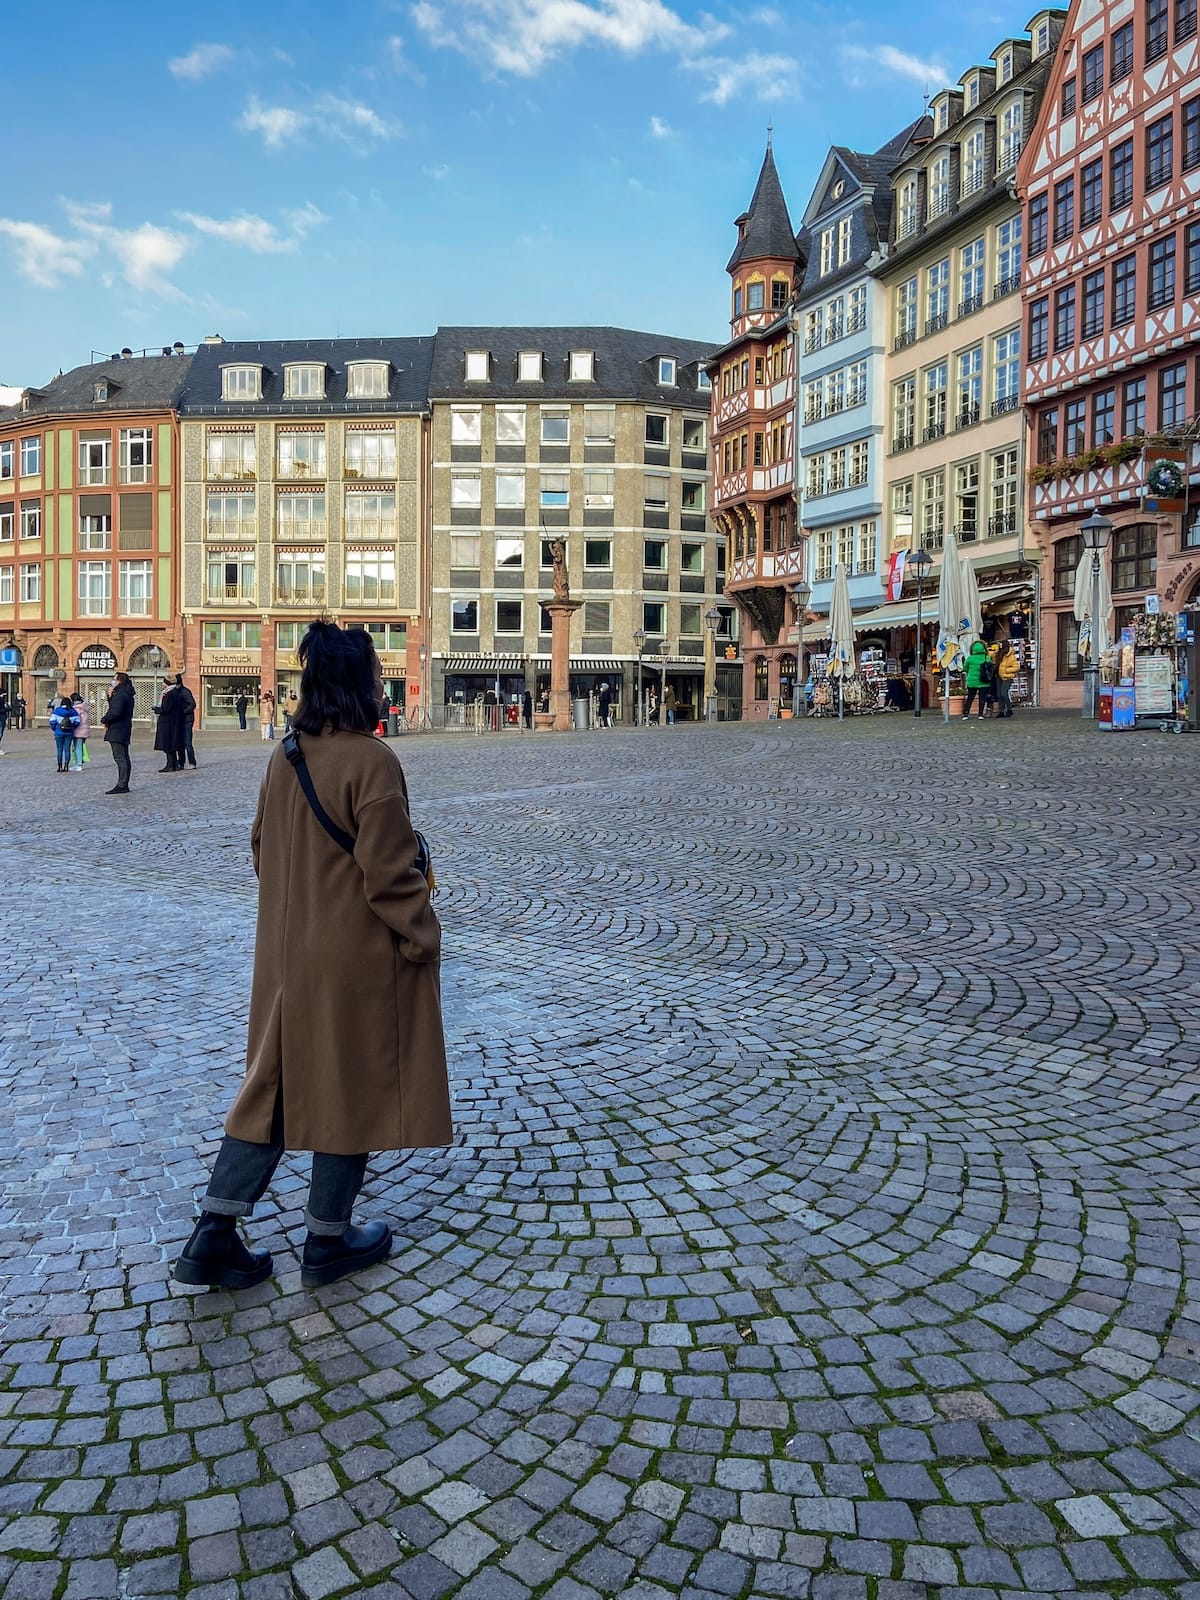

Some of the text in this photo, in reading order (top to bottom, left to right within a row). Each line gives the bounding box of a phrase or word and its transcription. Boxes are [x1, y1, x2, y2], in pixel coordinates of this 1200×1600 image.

[1, 649, 16, 665] U
[82, 651, 111, 659] BRILLEN
[78, 659, 115, 669] WEISS
